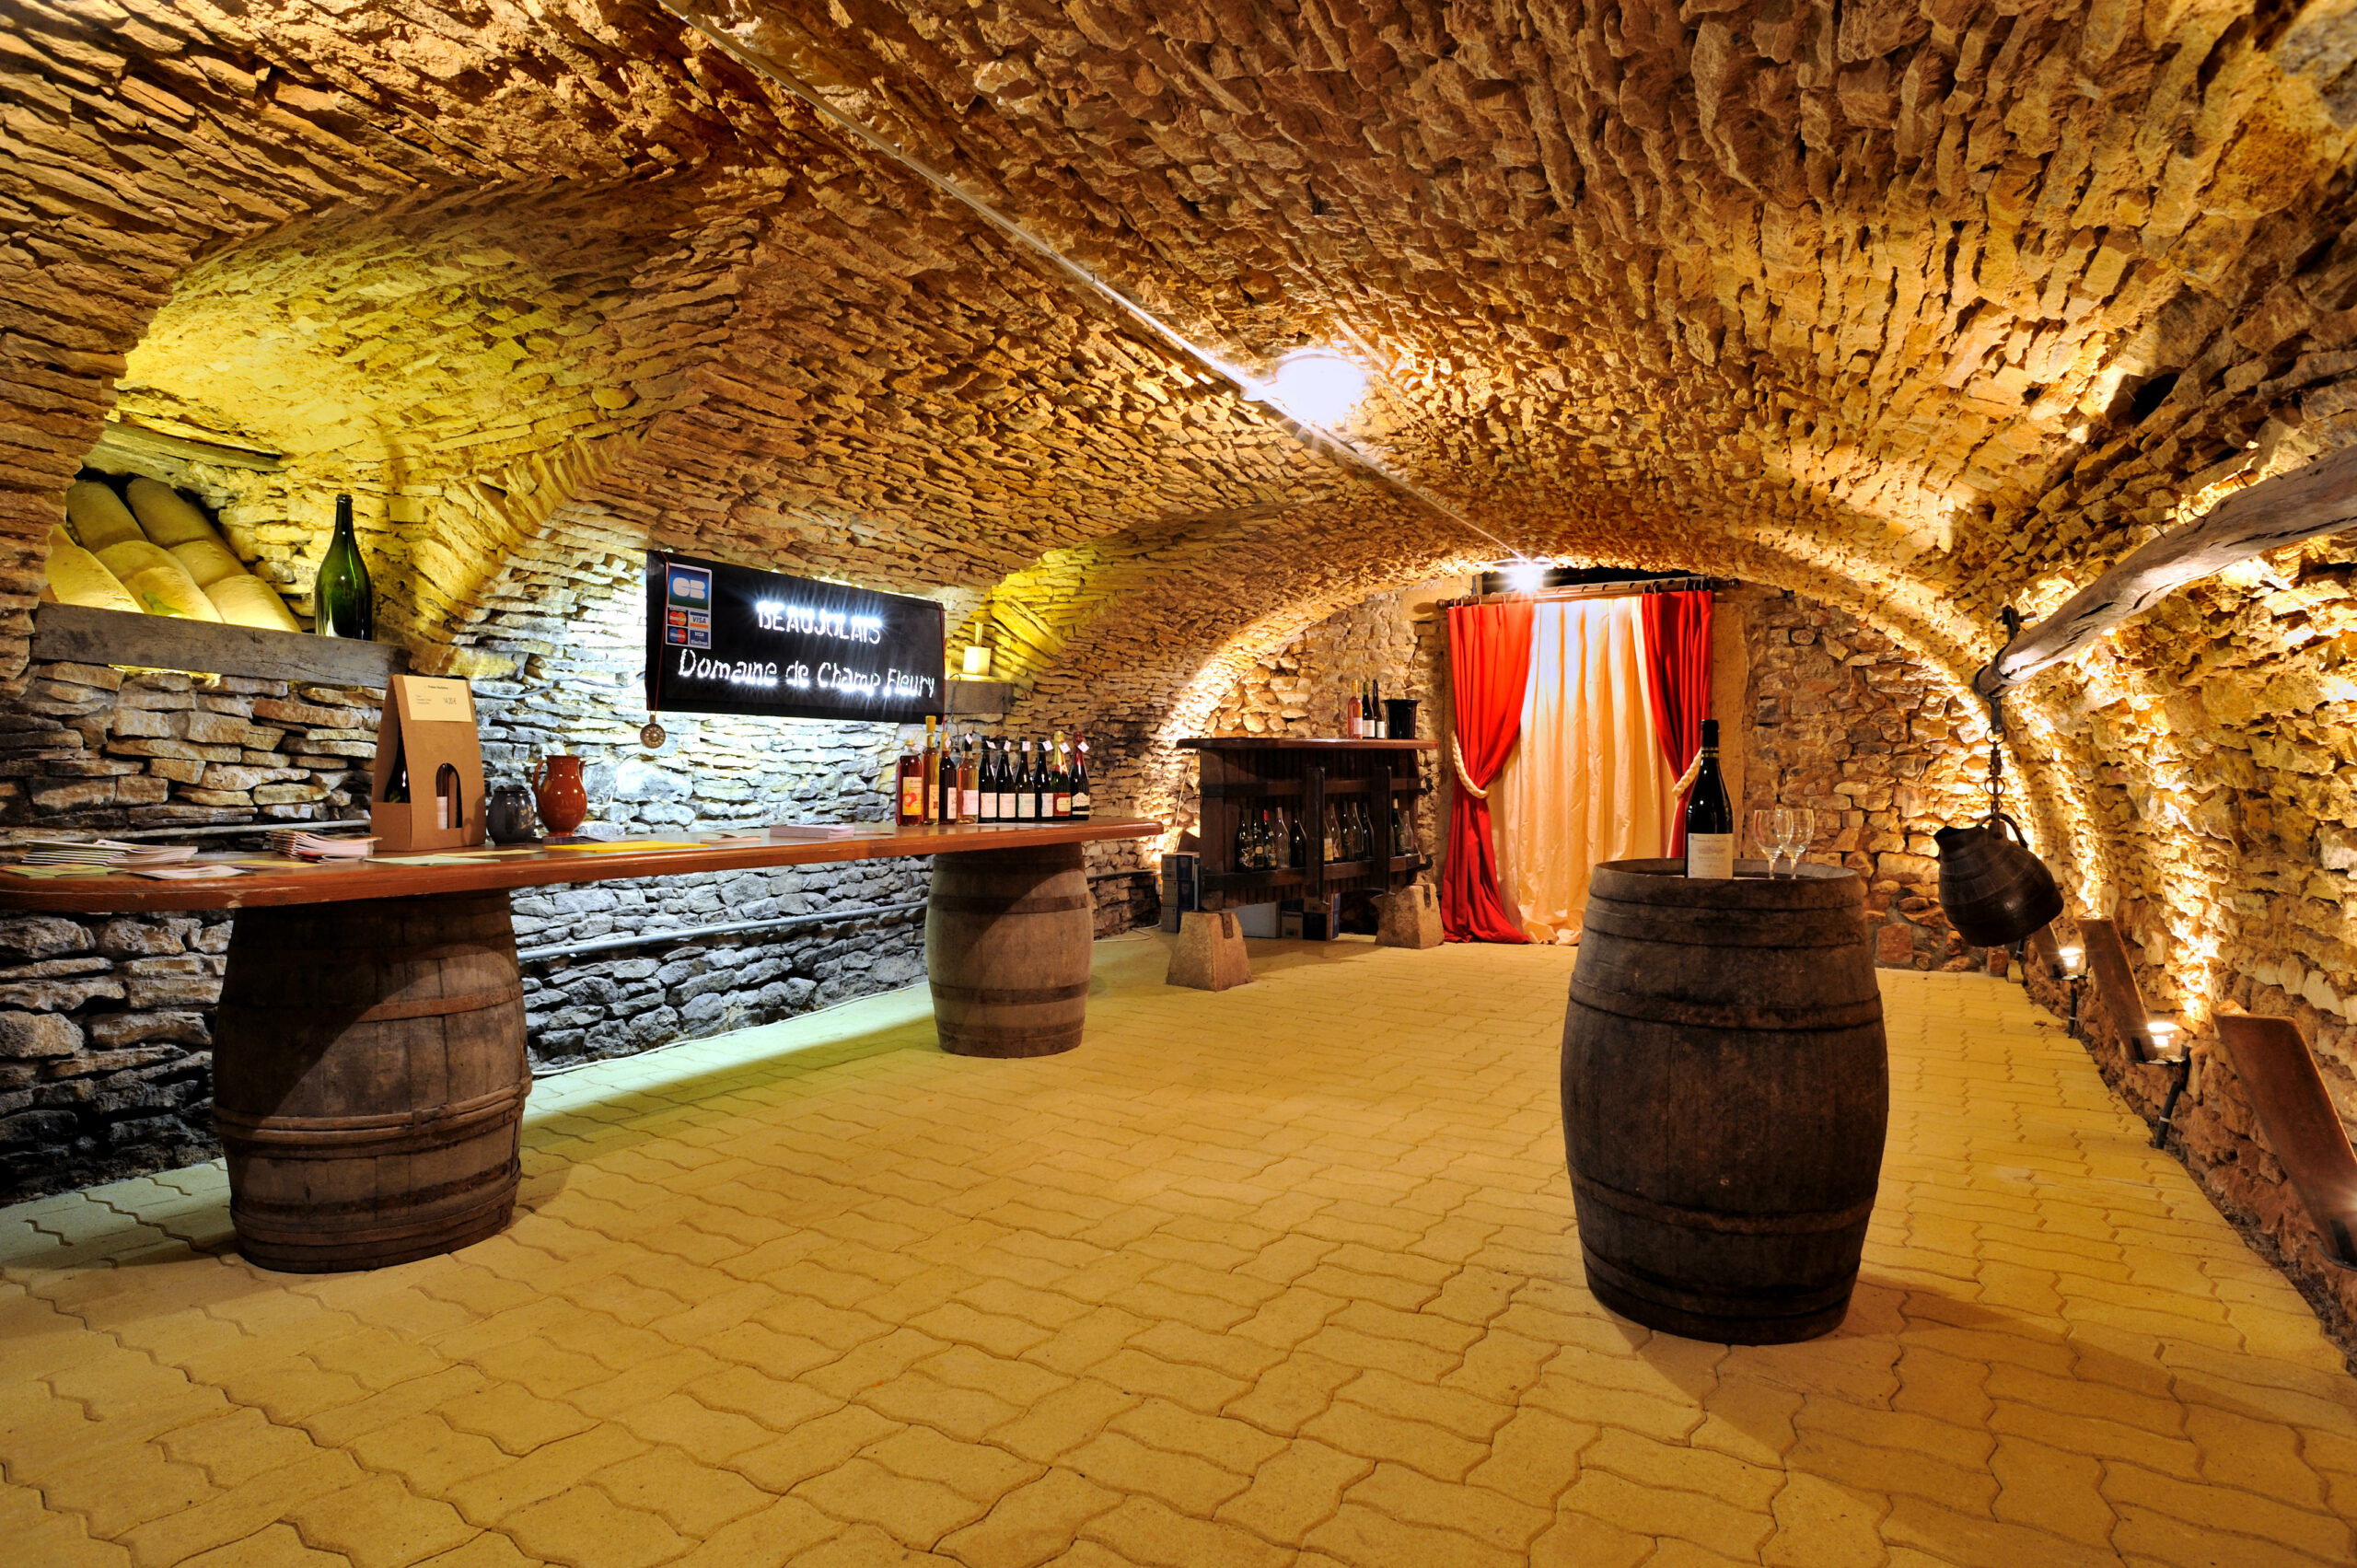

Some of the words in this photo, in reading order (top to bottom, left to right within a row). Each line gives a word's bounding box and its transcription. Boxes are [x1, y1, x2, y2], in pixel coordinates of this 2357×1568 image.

[672, 577, 705, 599] CB
[756, 600, 883, 645] BEAUJOLAIS
[679, 648, 778, 685] Domaine
[785, 660, 810, 688] de
[818, 662, 880, 697] Champ
[882, 668, 935, 698] Fleury
